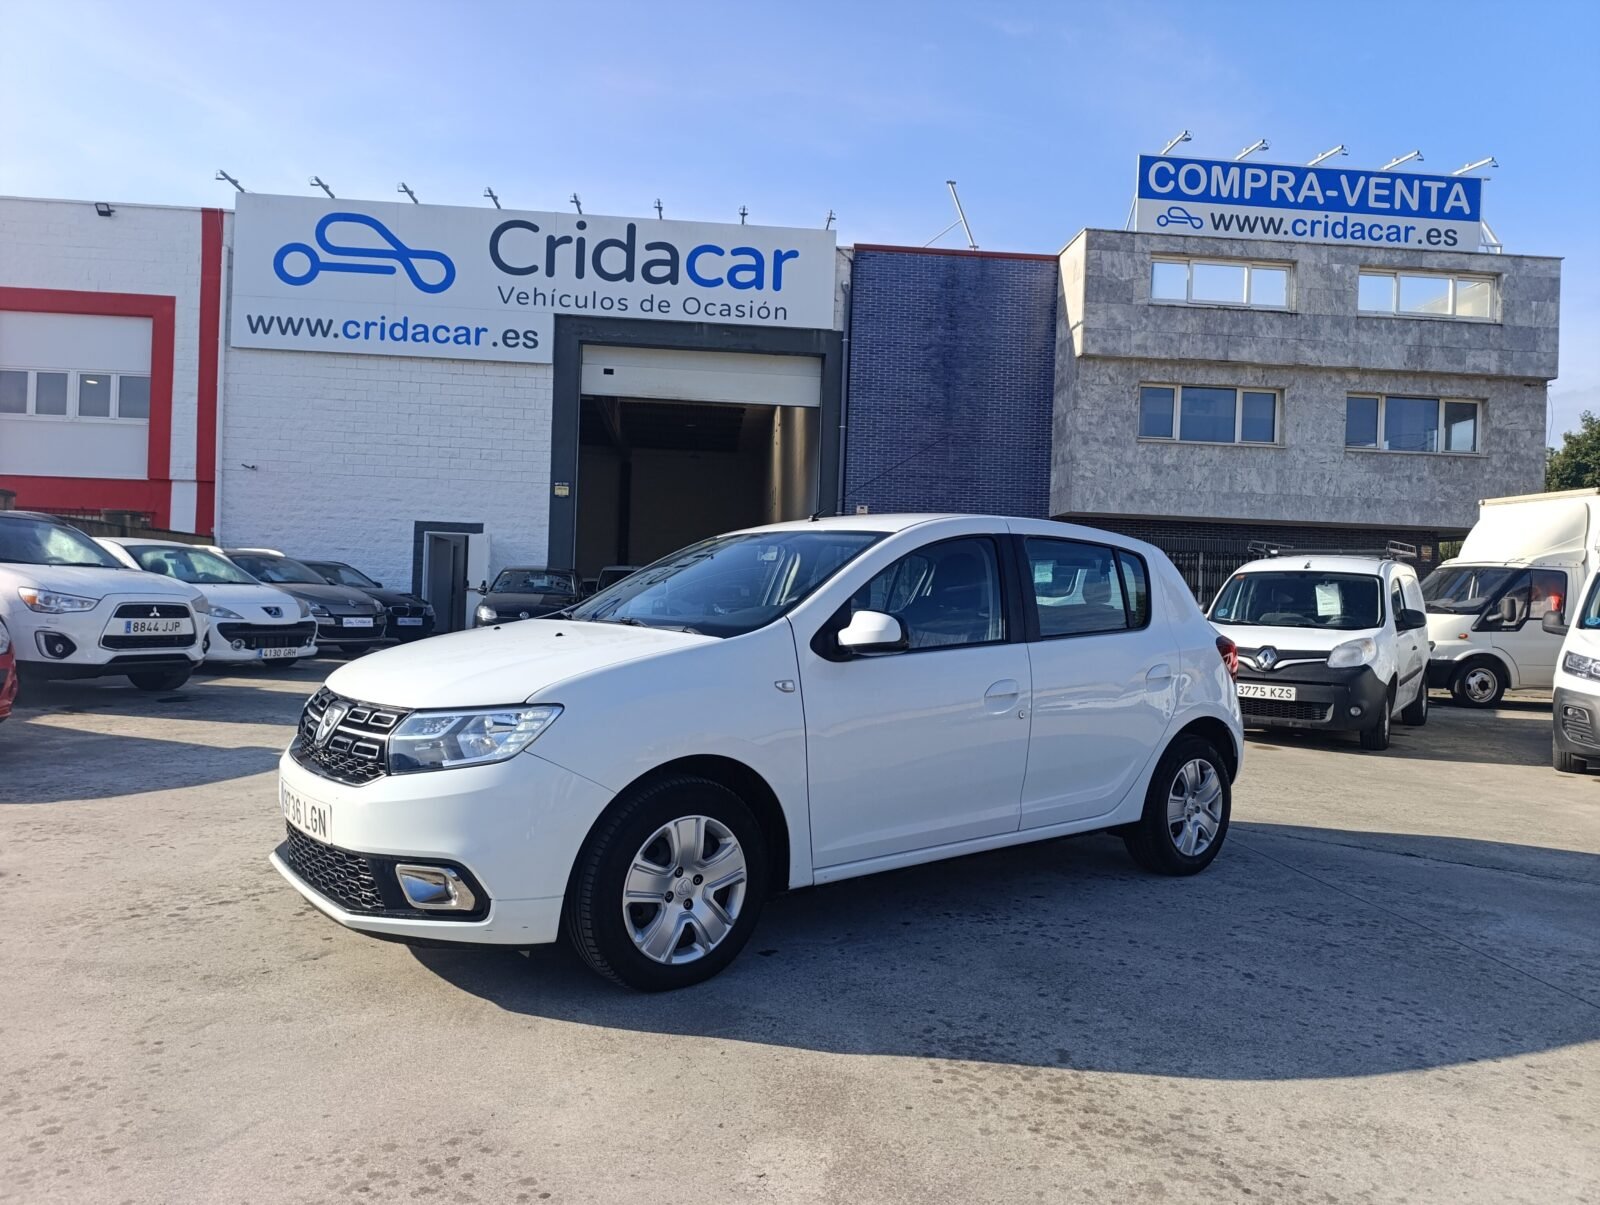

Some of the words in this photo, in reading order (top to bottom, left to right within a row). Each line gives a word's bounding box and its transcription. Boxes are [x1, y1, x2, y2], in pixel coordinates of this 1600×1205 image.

[1148, 161, 1471, 215] COMPRA-VENTA
[1210, 212, 1458, 248] www.cridacar.es
[489, 219, 800, 292] Cridacar
[497, 285, 629, 312] Vehículos
[639, 293, 671, 314] de
[682, 297, 788, 321] Ocasión
[246, 314, 539, 350] www.cridacar.es
[132, 621, 160, 633] 8844
[161, 621, 181, 632] JJP
[263, 648, 282, 657] 4130
[1238, 685, 1266, 697] 3775
[1270, 687, 1292, 699] KZS
[303, 801, 326, 838] LGN
